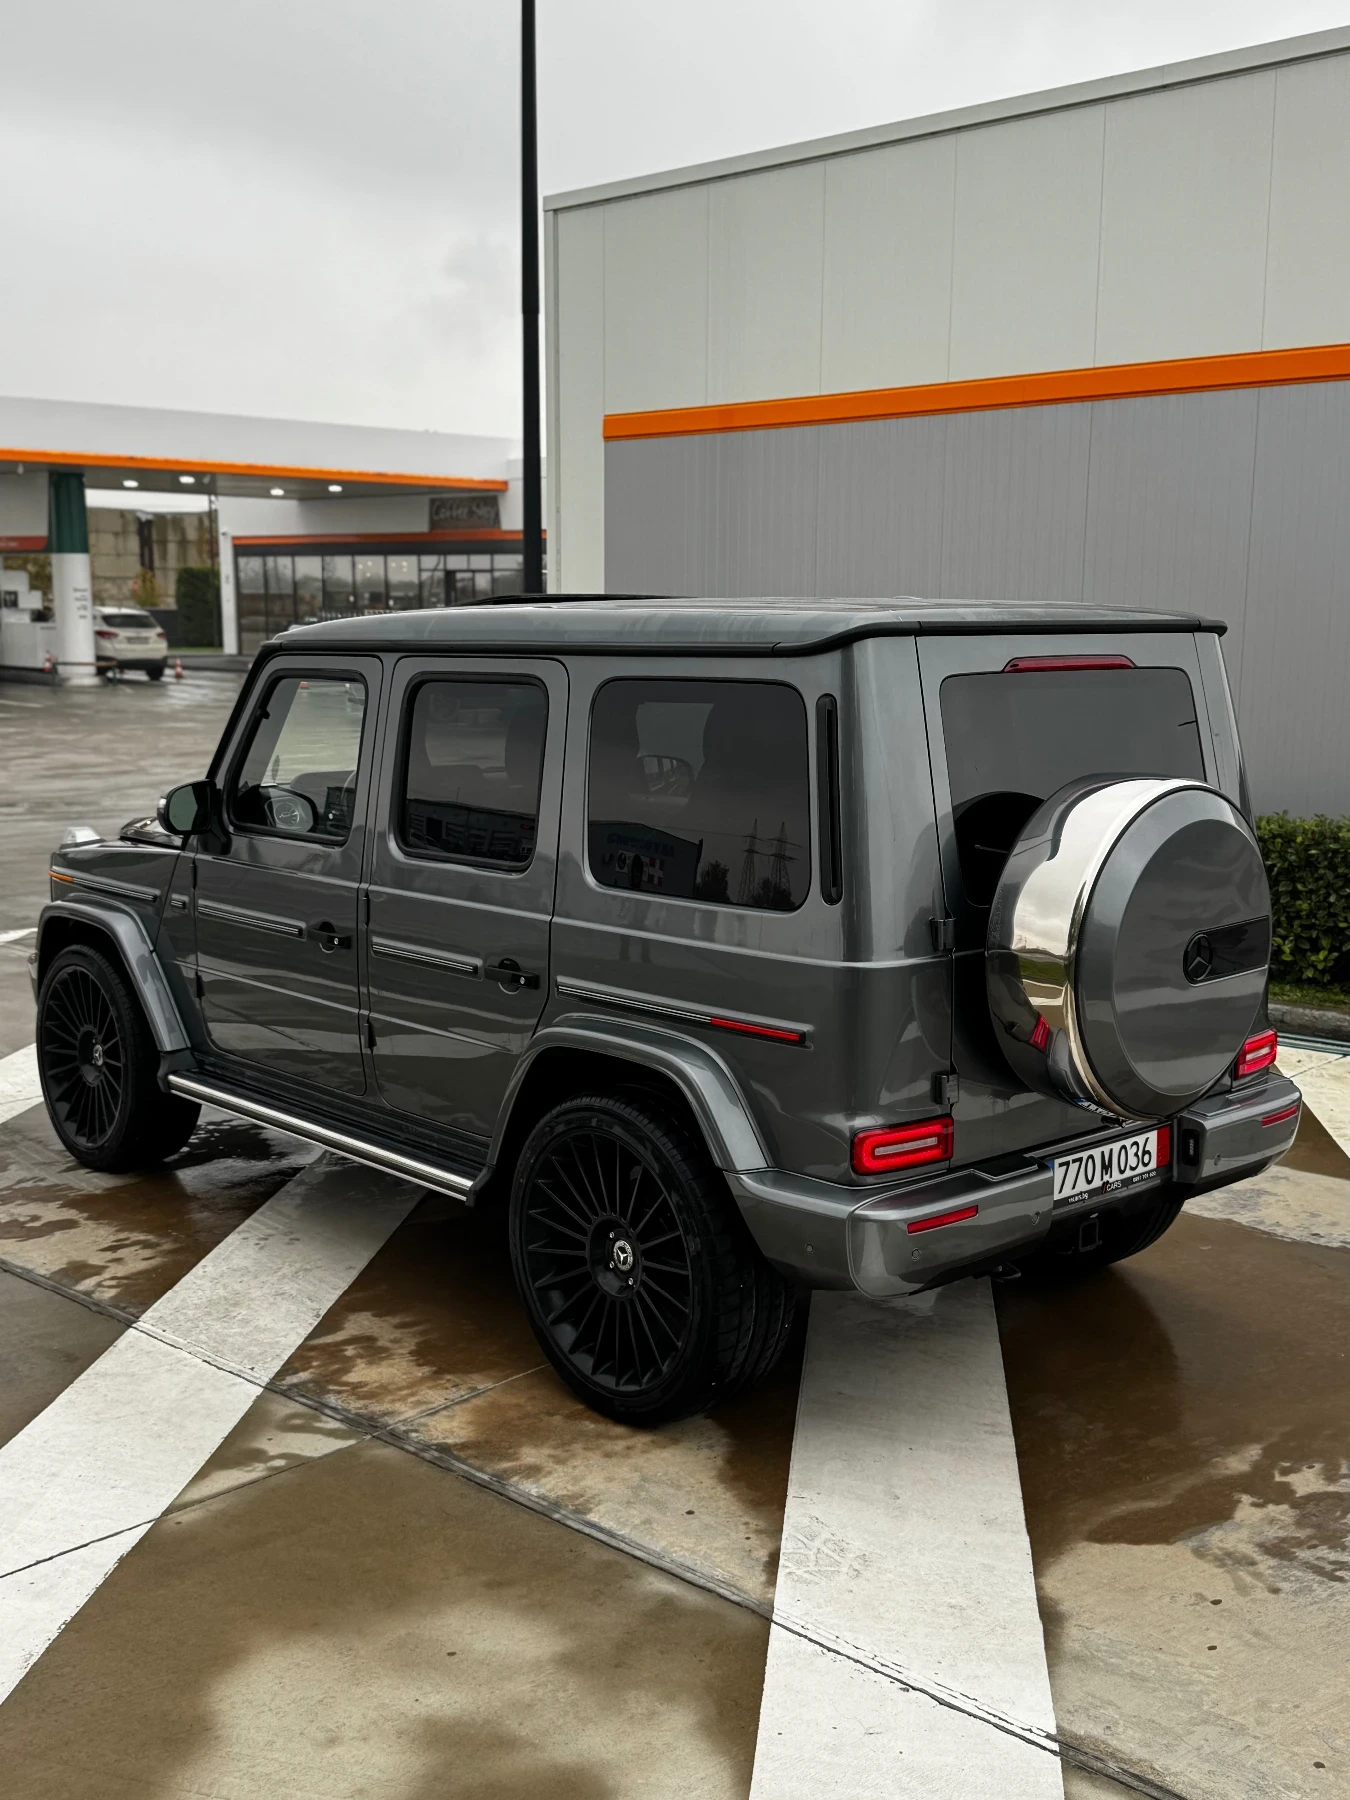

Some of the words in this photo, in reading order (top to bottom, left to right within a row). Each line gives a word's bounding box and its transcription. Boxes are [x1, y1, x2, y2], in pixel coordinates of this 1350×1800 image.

[1058, 1153, 1096, 1195] 770
[1100, 1147, 1113, 1182] M
[1117, 1136, 1152, 1175] 036
